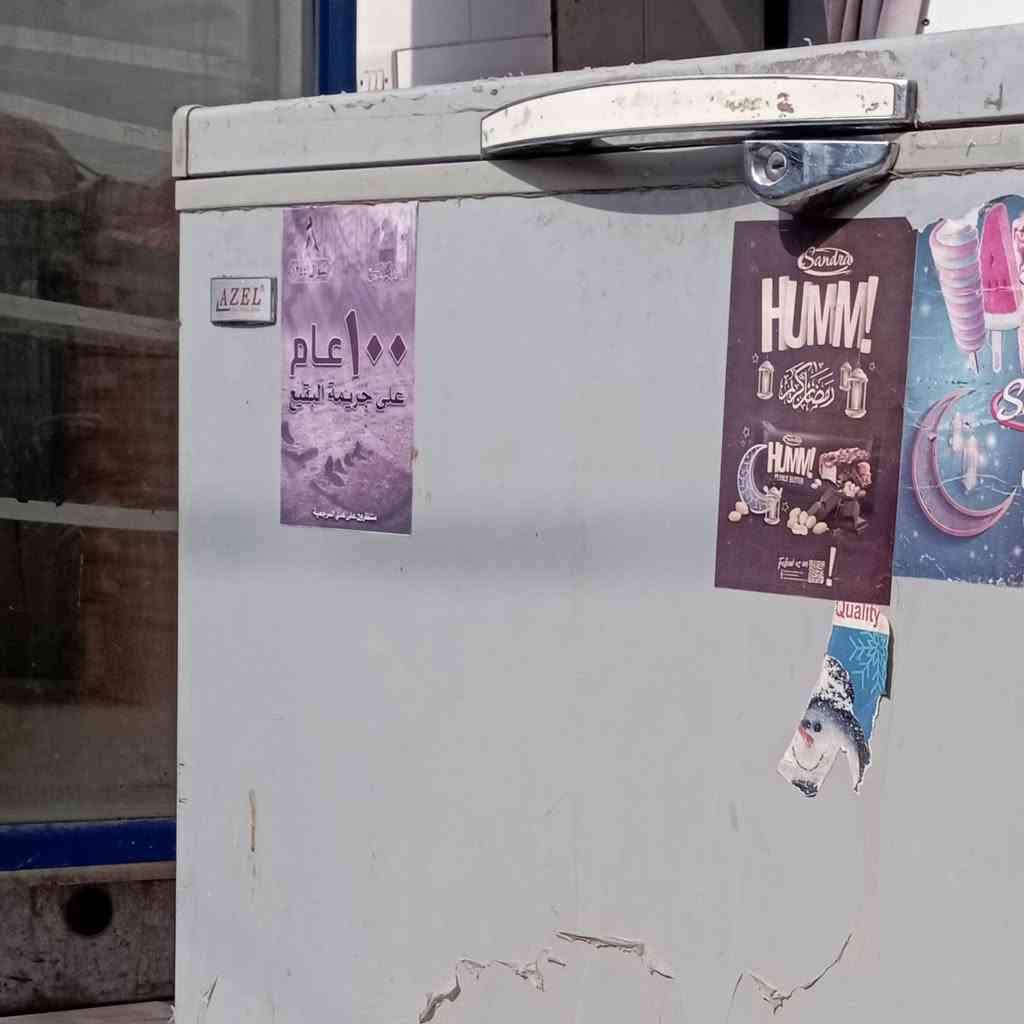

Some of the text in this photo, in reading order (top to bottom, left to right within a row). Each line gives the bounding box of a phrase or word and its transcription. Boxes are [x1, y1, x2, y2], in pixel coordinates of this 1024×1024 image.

[799, 247, 853, 269] Sandra
[762, 276, 879, 354] HUMM!
[289, 323, 342, 378] عام
[376, 385, 406, 413] على
[767, 441, 816, 479] HUMM!
